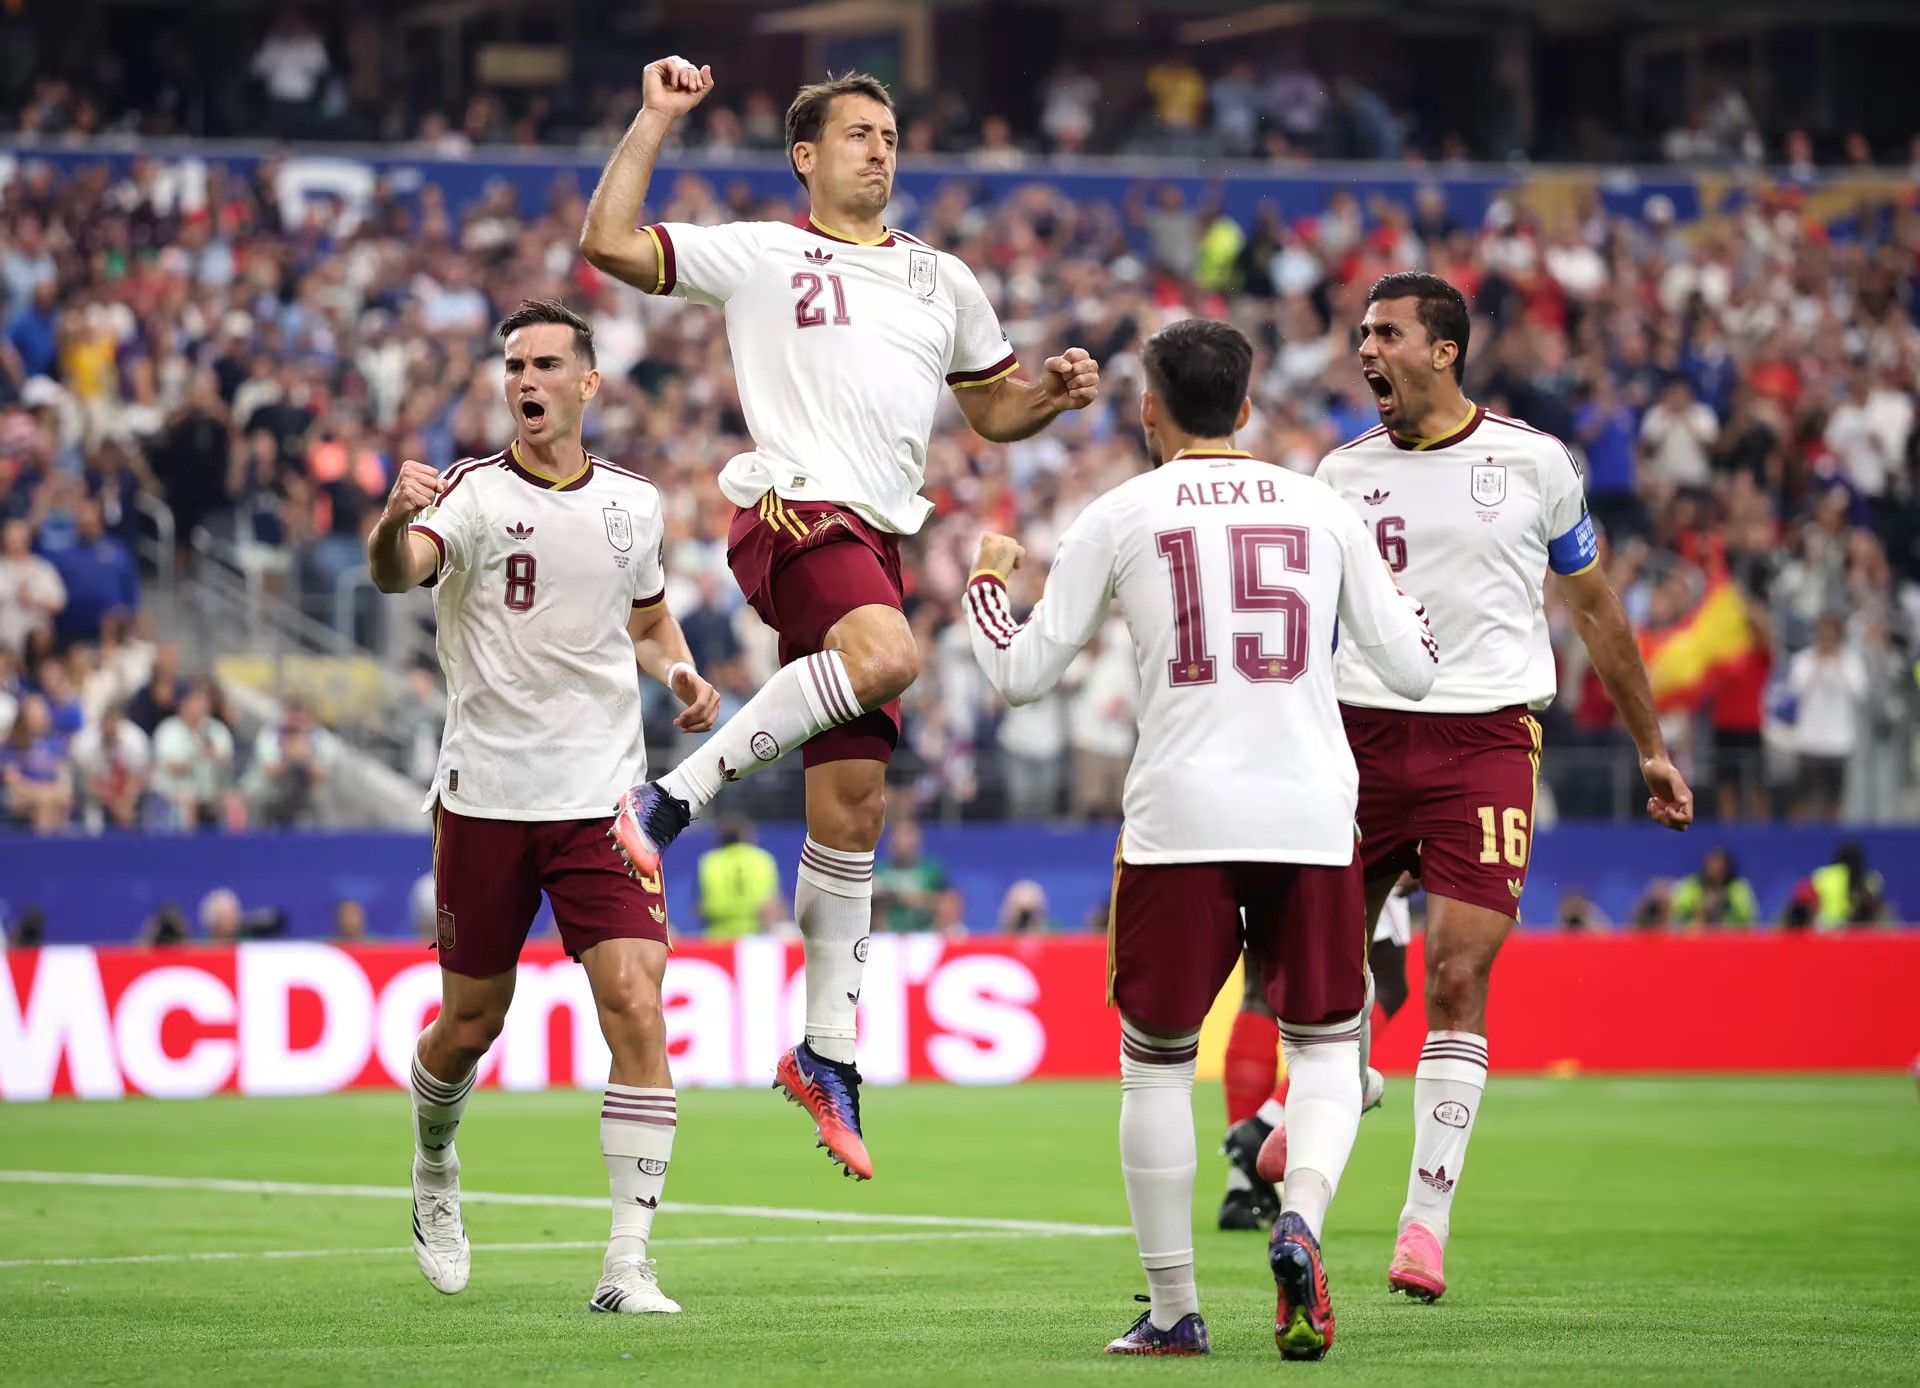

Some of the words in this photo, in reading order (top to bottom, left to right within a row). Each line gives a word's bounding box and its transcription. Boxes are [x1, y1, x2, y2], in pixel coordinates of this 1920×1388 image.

[791, 272, 851, 329] 21
[1176, 481, 1250, 507] ALEX
[1256, 480, 1284, 503] B.
[1363, 515, 1408, 574] 6
[504, 553, 536, 612] 8
[1155, 525, 1310, 688] 15
[1477, 806, 1527, 868] 16
